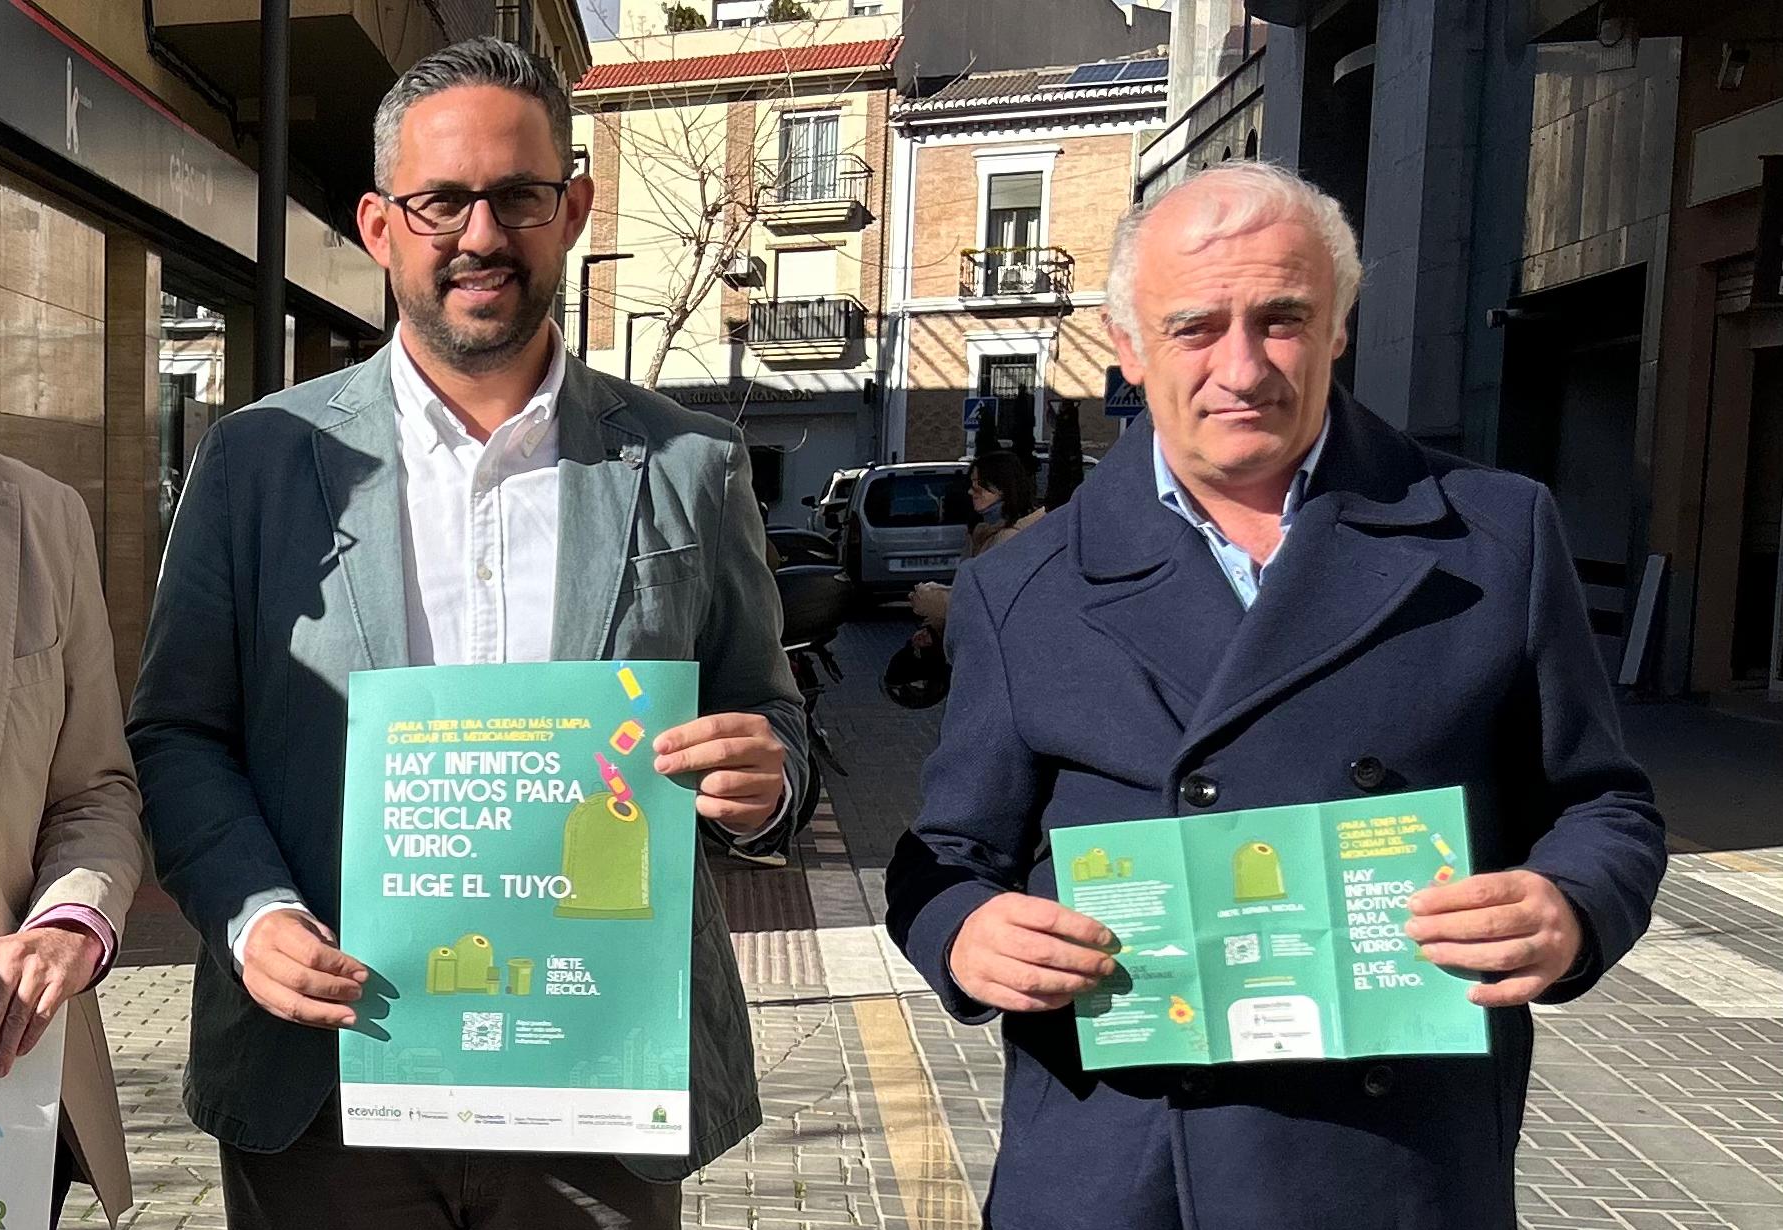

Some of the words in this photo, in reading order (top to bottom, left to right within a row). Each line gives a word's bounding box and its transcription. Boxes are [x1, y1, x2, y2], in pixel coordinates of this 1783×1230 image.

[385, 752, 437, 776] HAY
[445, 751, 561, 775] INFINITOS
[384, 779, 507, 803] MOTIVOS
[515, 779, 585, 803] PARA
[383, 806, 512, 831] RECICLAR
[384, 834, 477, 858] VIDRIO.
[1343, 869, 1375, 883] HAY
[382, 873, 454, 898] ELIGE
[462, 873, 491, 898] EL
[500, 874, 577, 899] TUYO.
[1345, 881, 1415, 897] INFINITOS
[1346, 896, 1410, 911] MOTIVO
[1348, 912, 1390, 925] PARA
[1352, 939, 1408, 954] VIDRIO.
[1353, 961, 1396, 976] ELIGE
[1354, 977, 1373, 990] EL
[1376, 973, 1424, 988] TUYO.
[347, 1105, 402, 1118] ecovidrio
